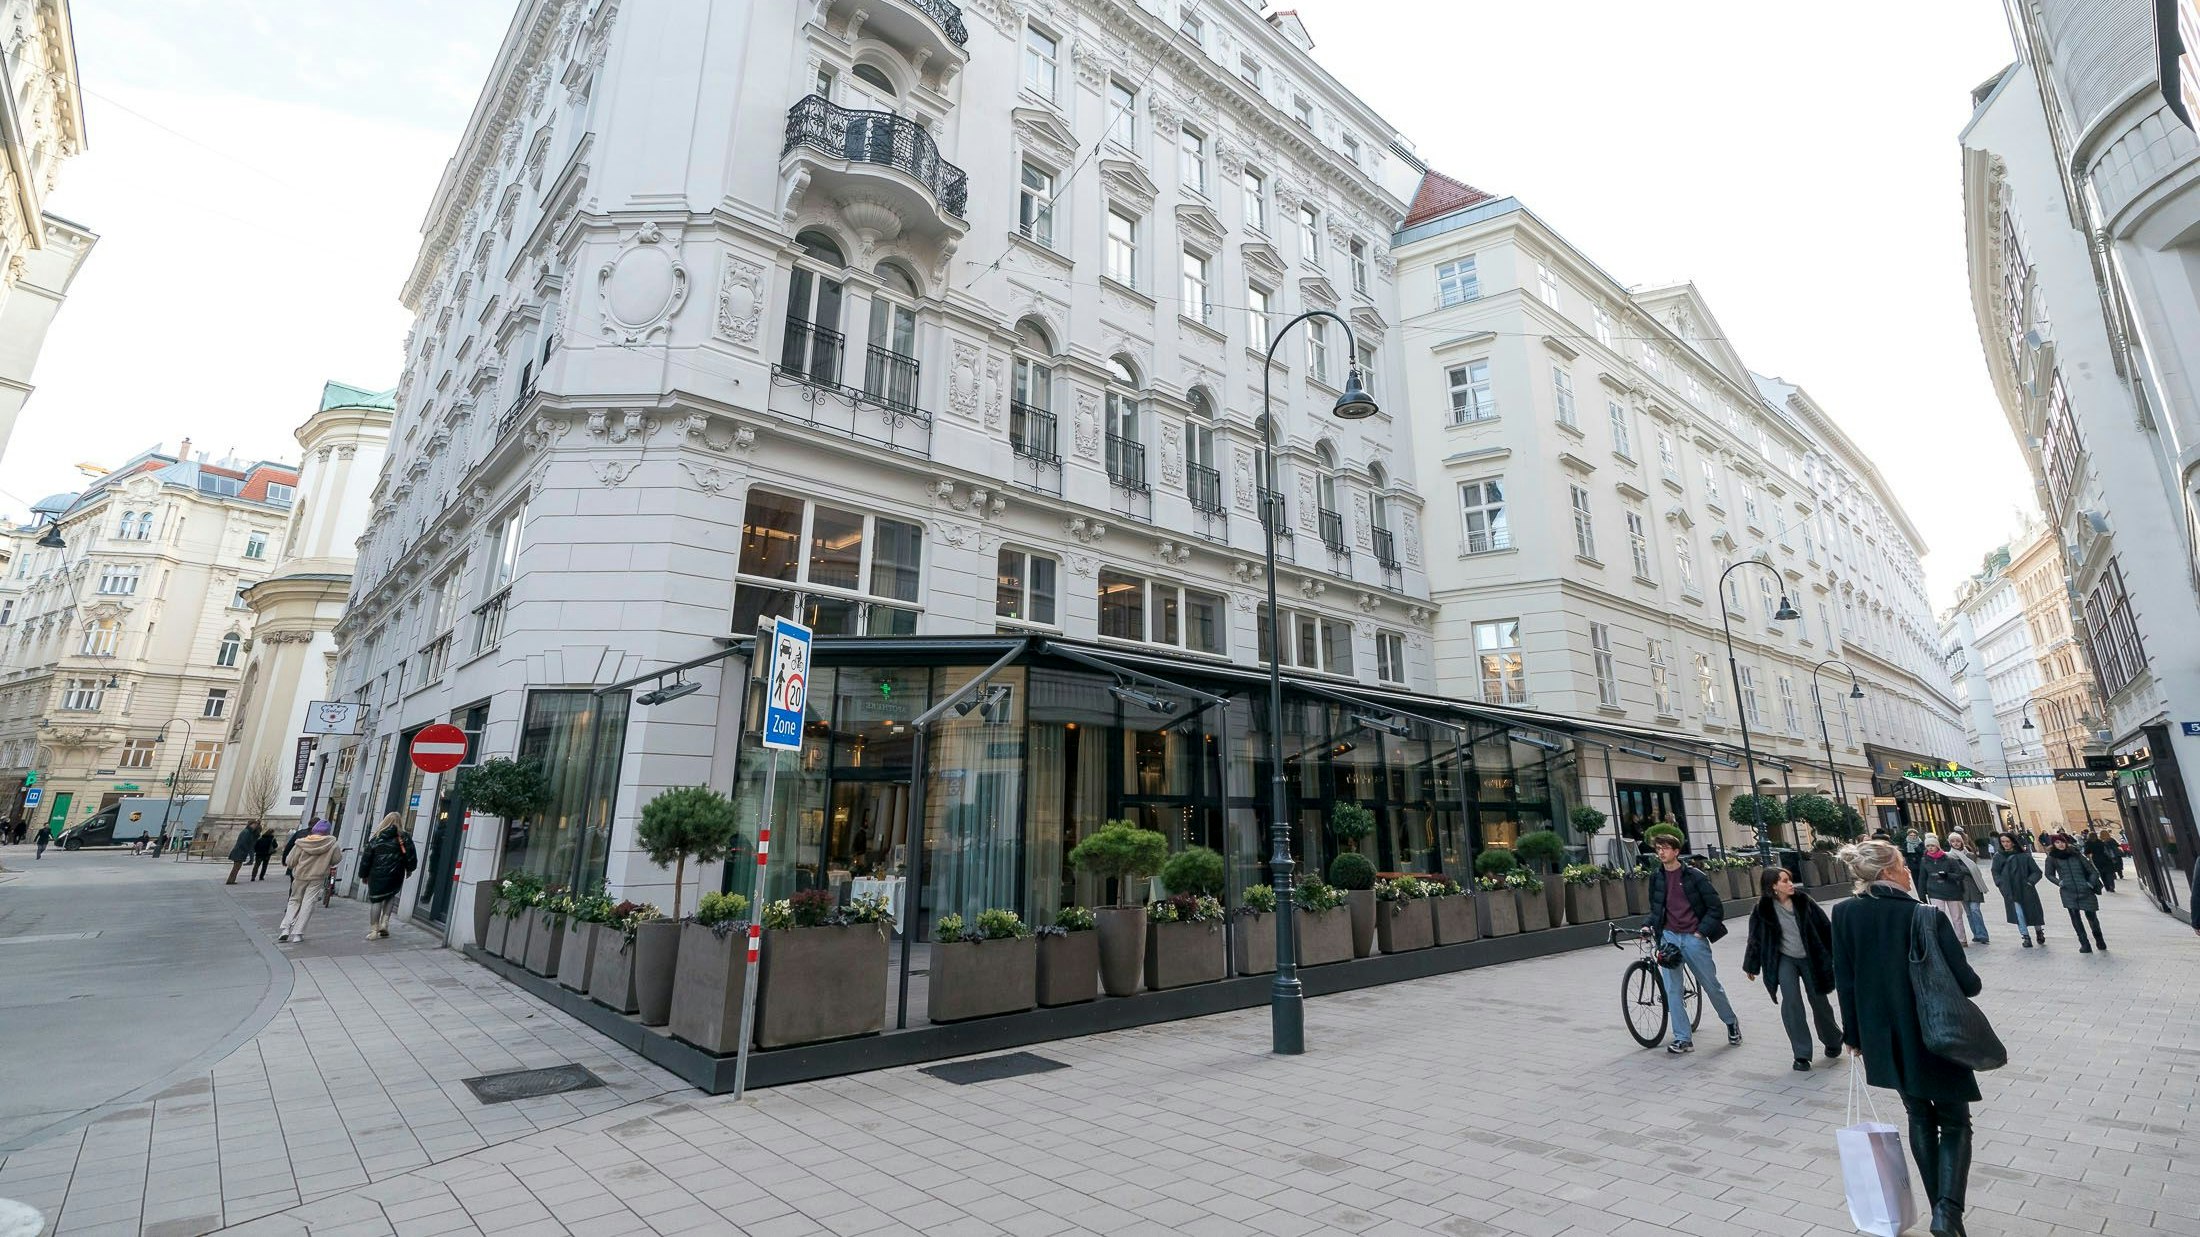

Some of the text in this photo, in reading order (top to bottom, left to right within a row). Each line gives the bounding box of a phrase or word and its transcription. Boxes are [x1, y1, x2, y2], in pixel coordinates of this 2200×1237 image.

[790, 685, 801, 707] 20
[773, 714, 796, 736] Zone
[1937, 770, 1972, 778] ROLEX
